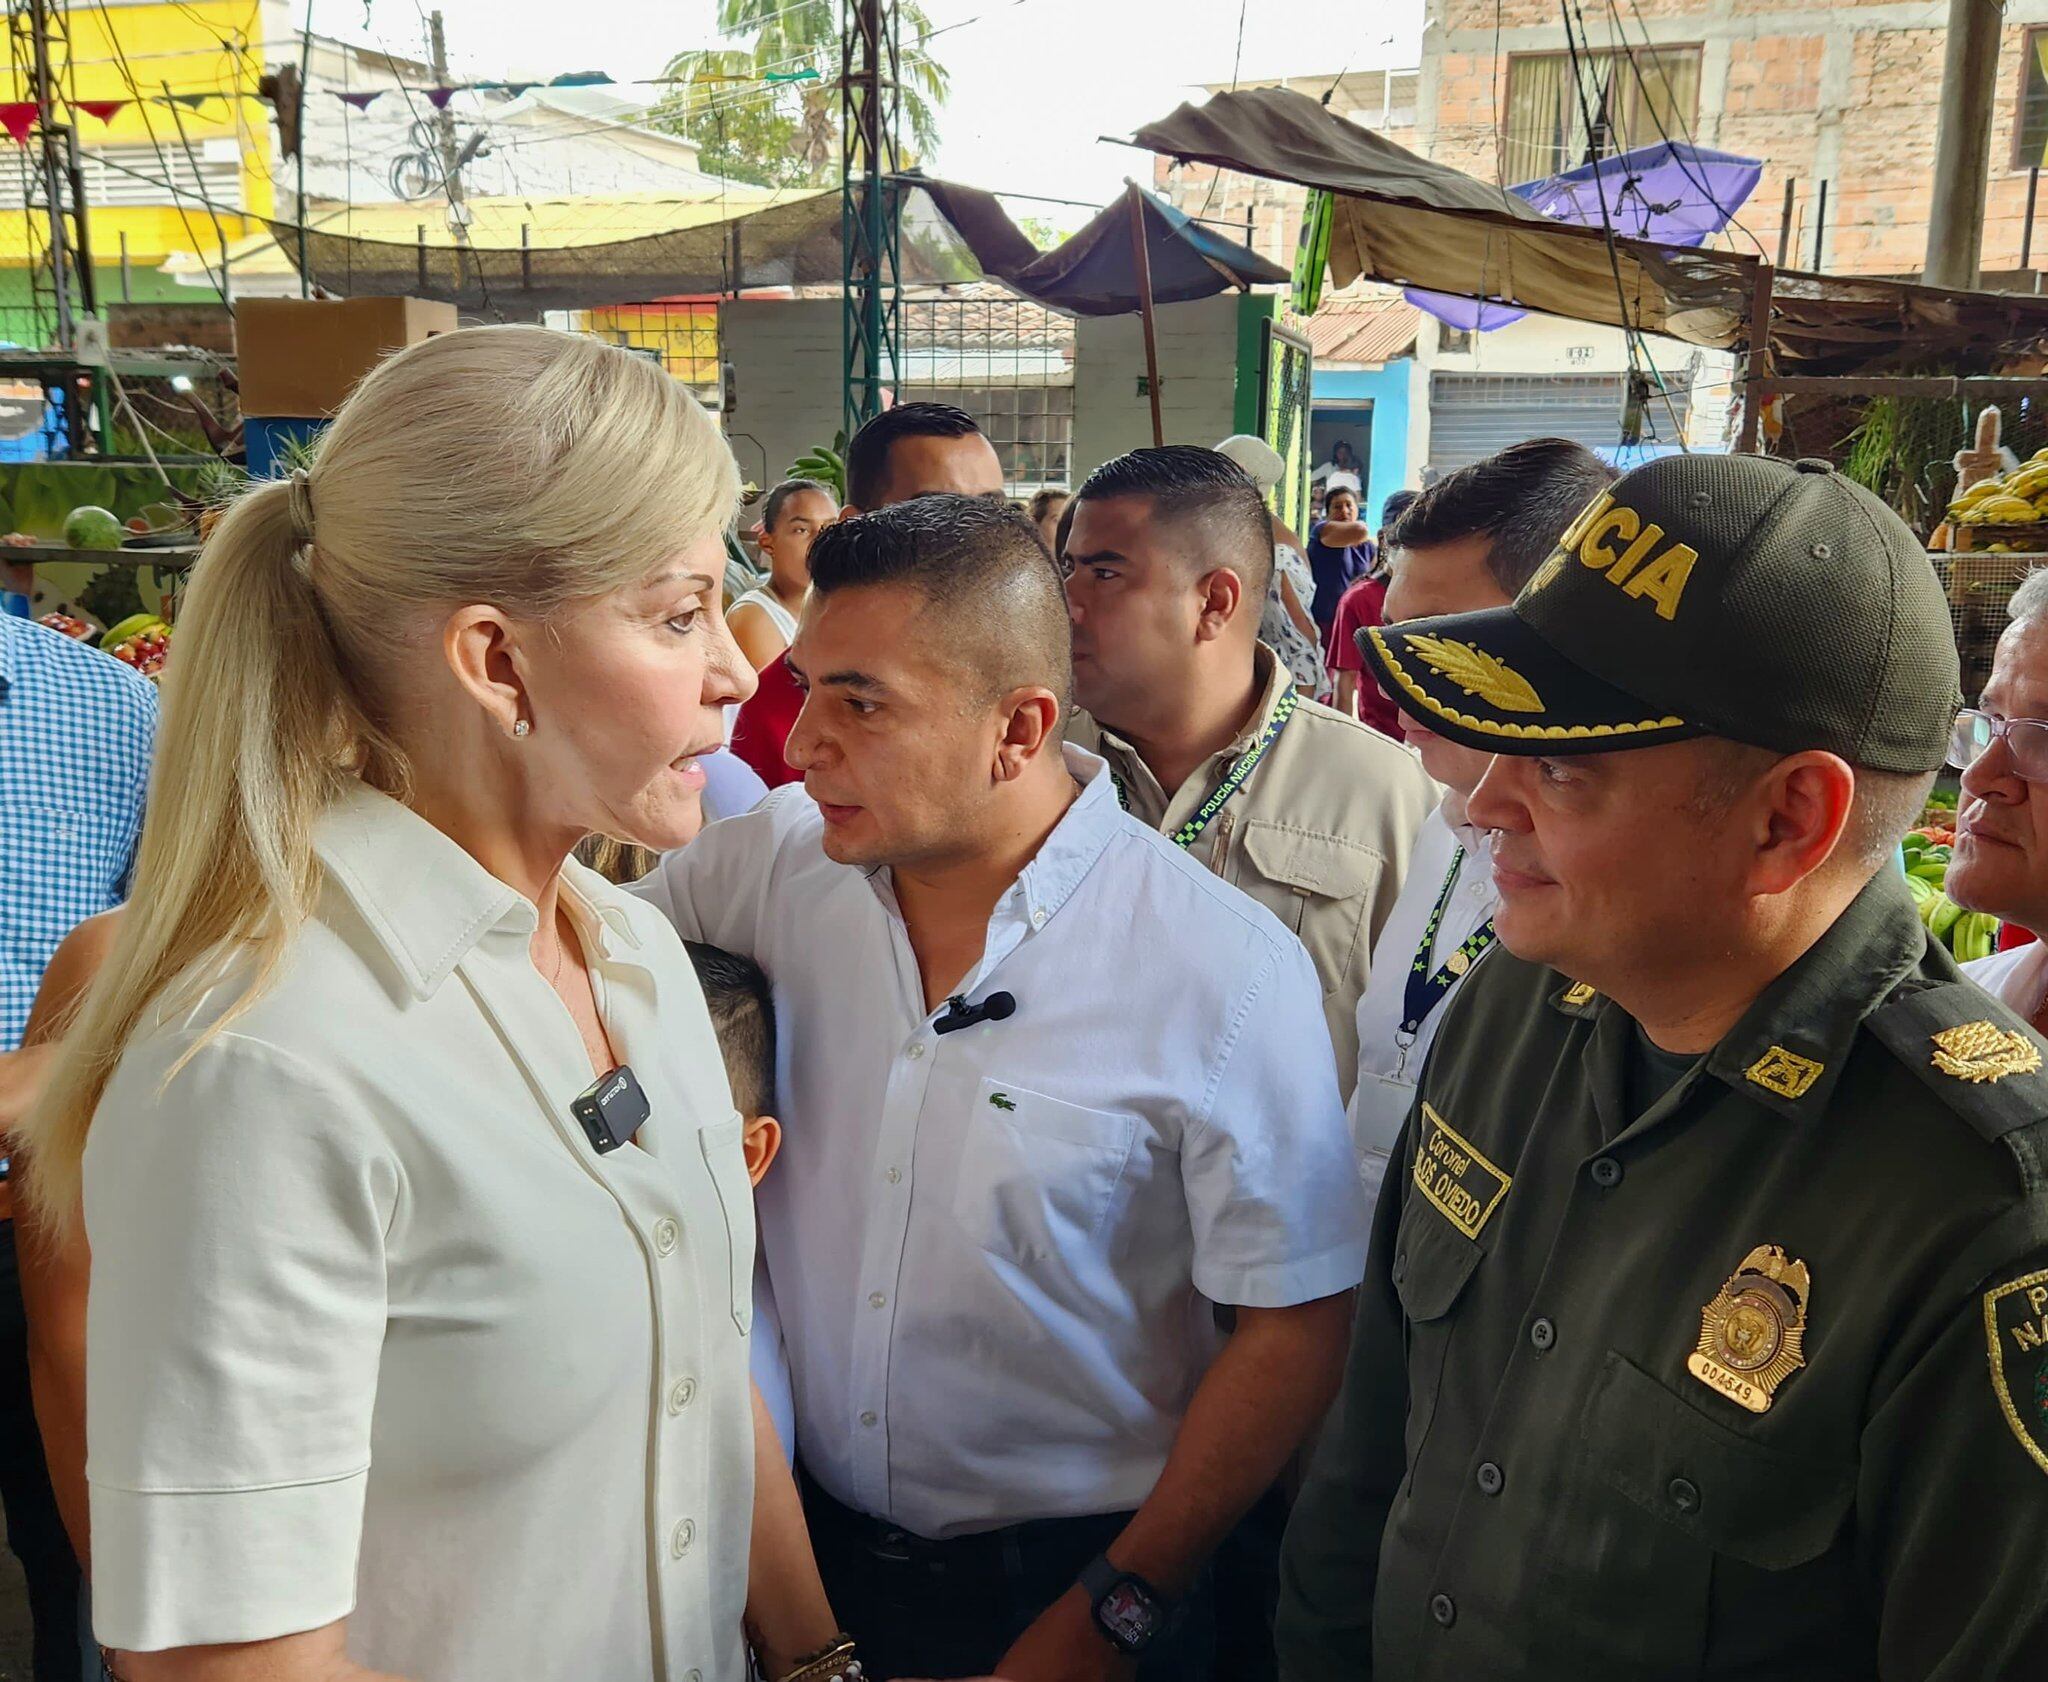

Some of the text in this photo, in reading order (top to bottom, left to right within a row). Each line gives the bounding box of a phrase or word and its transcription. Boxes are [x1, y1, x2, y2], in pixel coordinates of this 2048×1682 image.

[1200, 740, 1270, 819] POLICÍA NACIONAL
[1429, 1129, 1471, 1177] Coronel
[1435, 1174, 1480, 1224] OVIEDO
